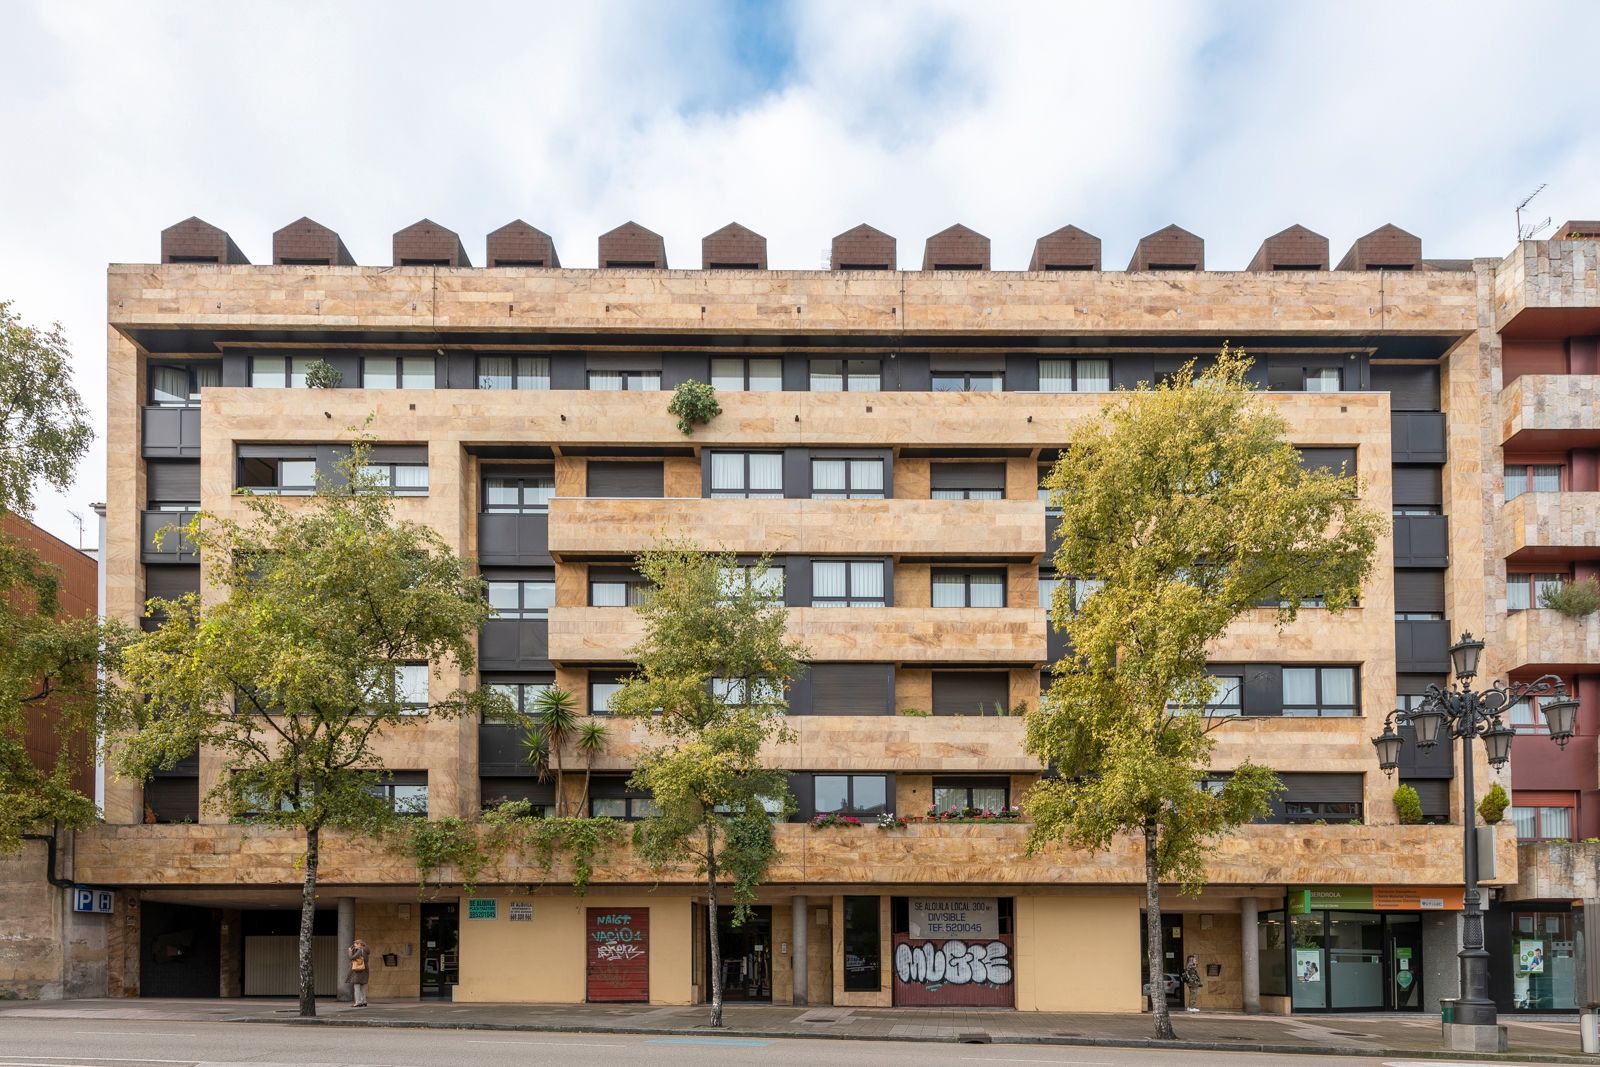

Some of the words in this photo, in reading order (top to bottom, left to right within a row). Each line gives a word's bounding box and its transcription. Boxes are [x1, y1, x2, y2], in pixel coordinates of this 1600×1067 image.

[80, 891, 92, 910] P
[914, 903, 923, 911] SE
[924, 903, 950, 911] ALQUILA
[951, 903, 970, 911] LOCAL
[973, 903, 985, 911] 300
[928, 912, 966, 922] DIVISIBLE
[945, 923, 982, 932] 5201045
